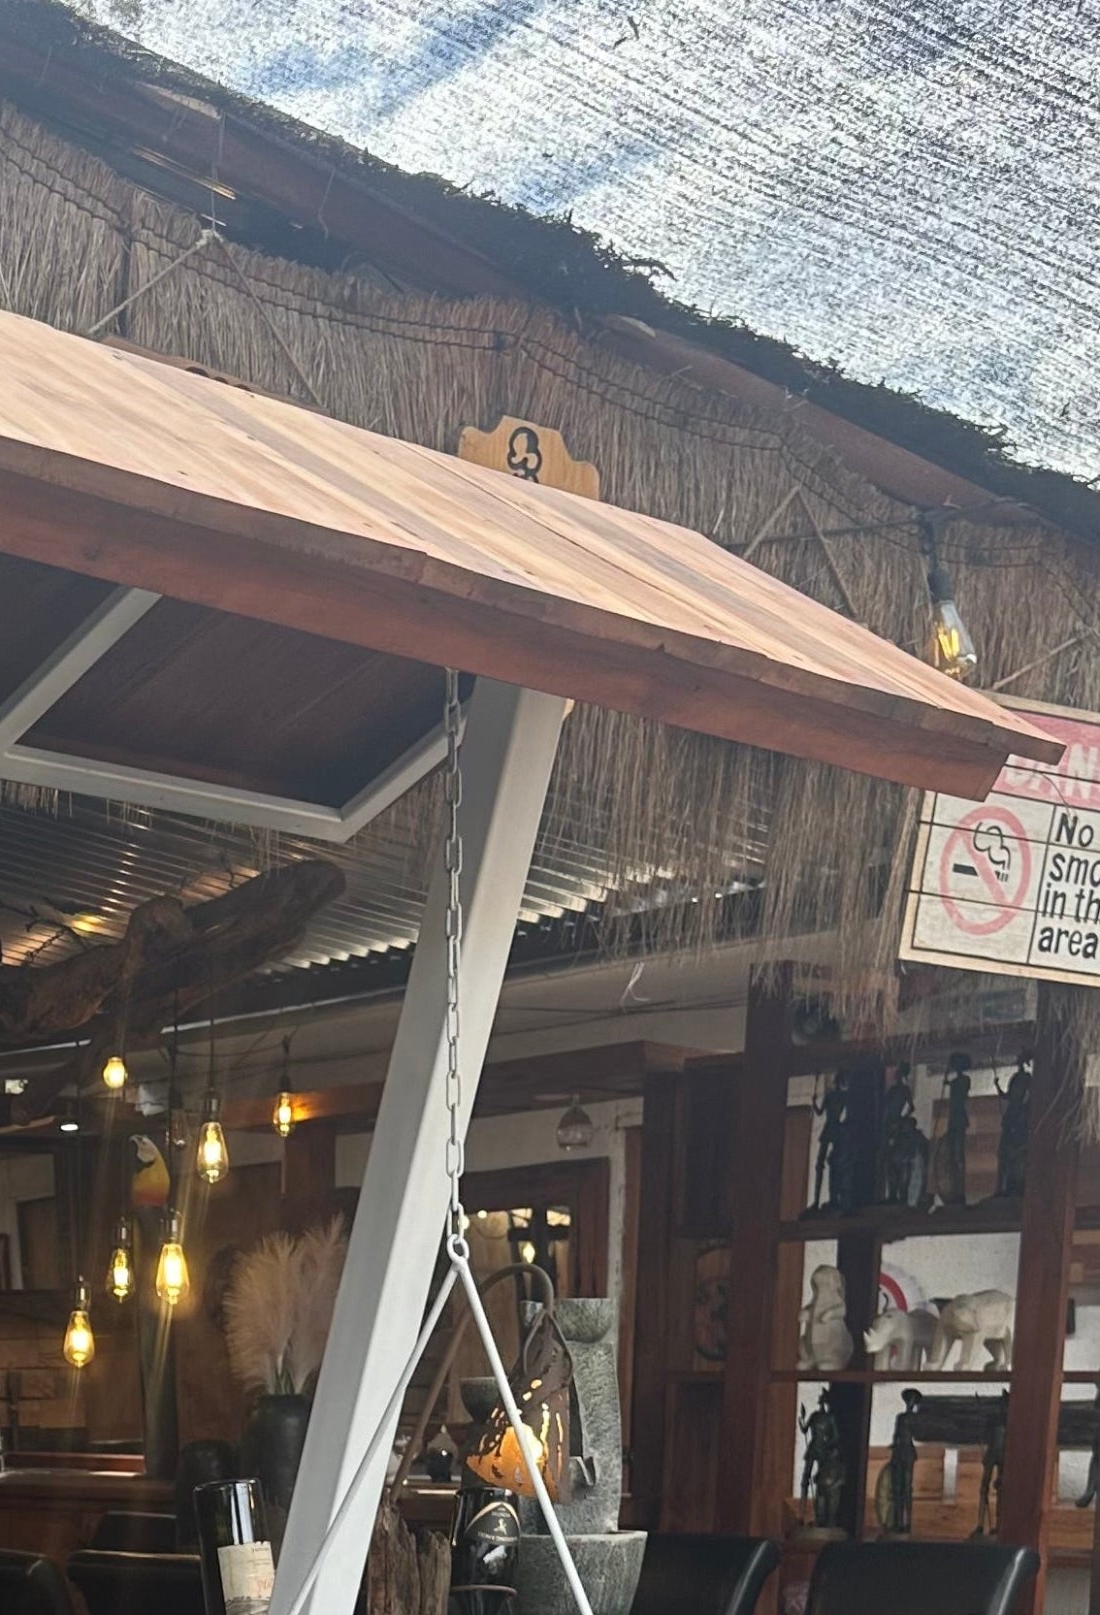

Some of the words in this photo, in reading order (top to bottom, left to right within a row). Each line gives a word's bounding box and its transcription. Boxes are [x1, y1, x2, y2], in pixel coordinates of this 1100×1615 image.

[1055, 813, 1094, 848] No
[1041, 882, 1067, 920] in
[1038, 926, 1098, 960] area
